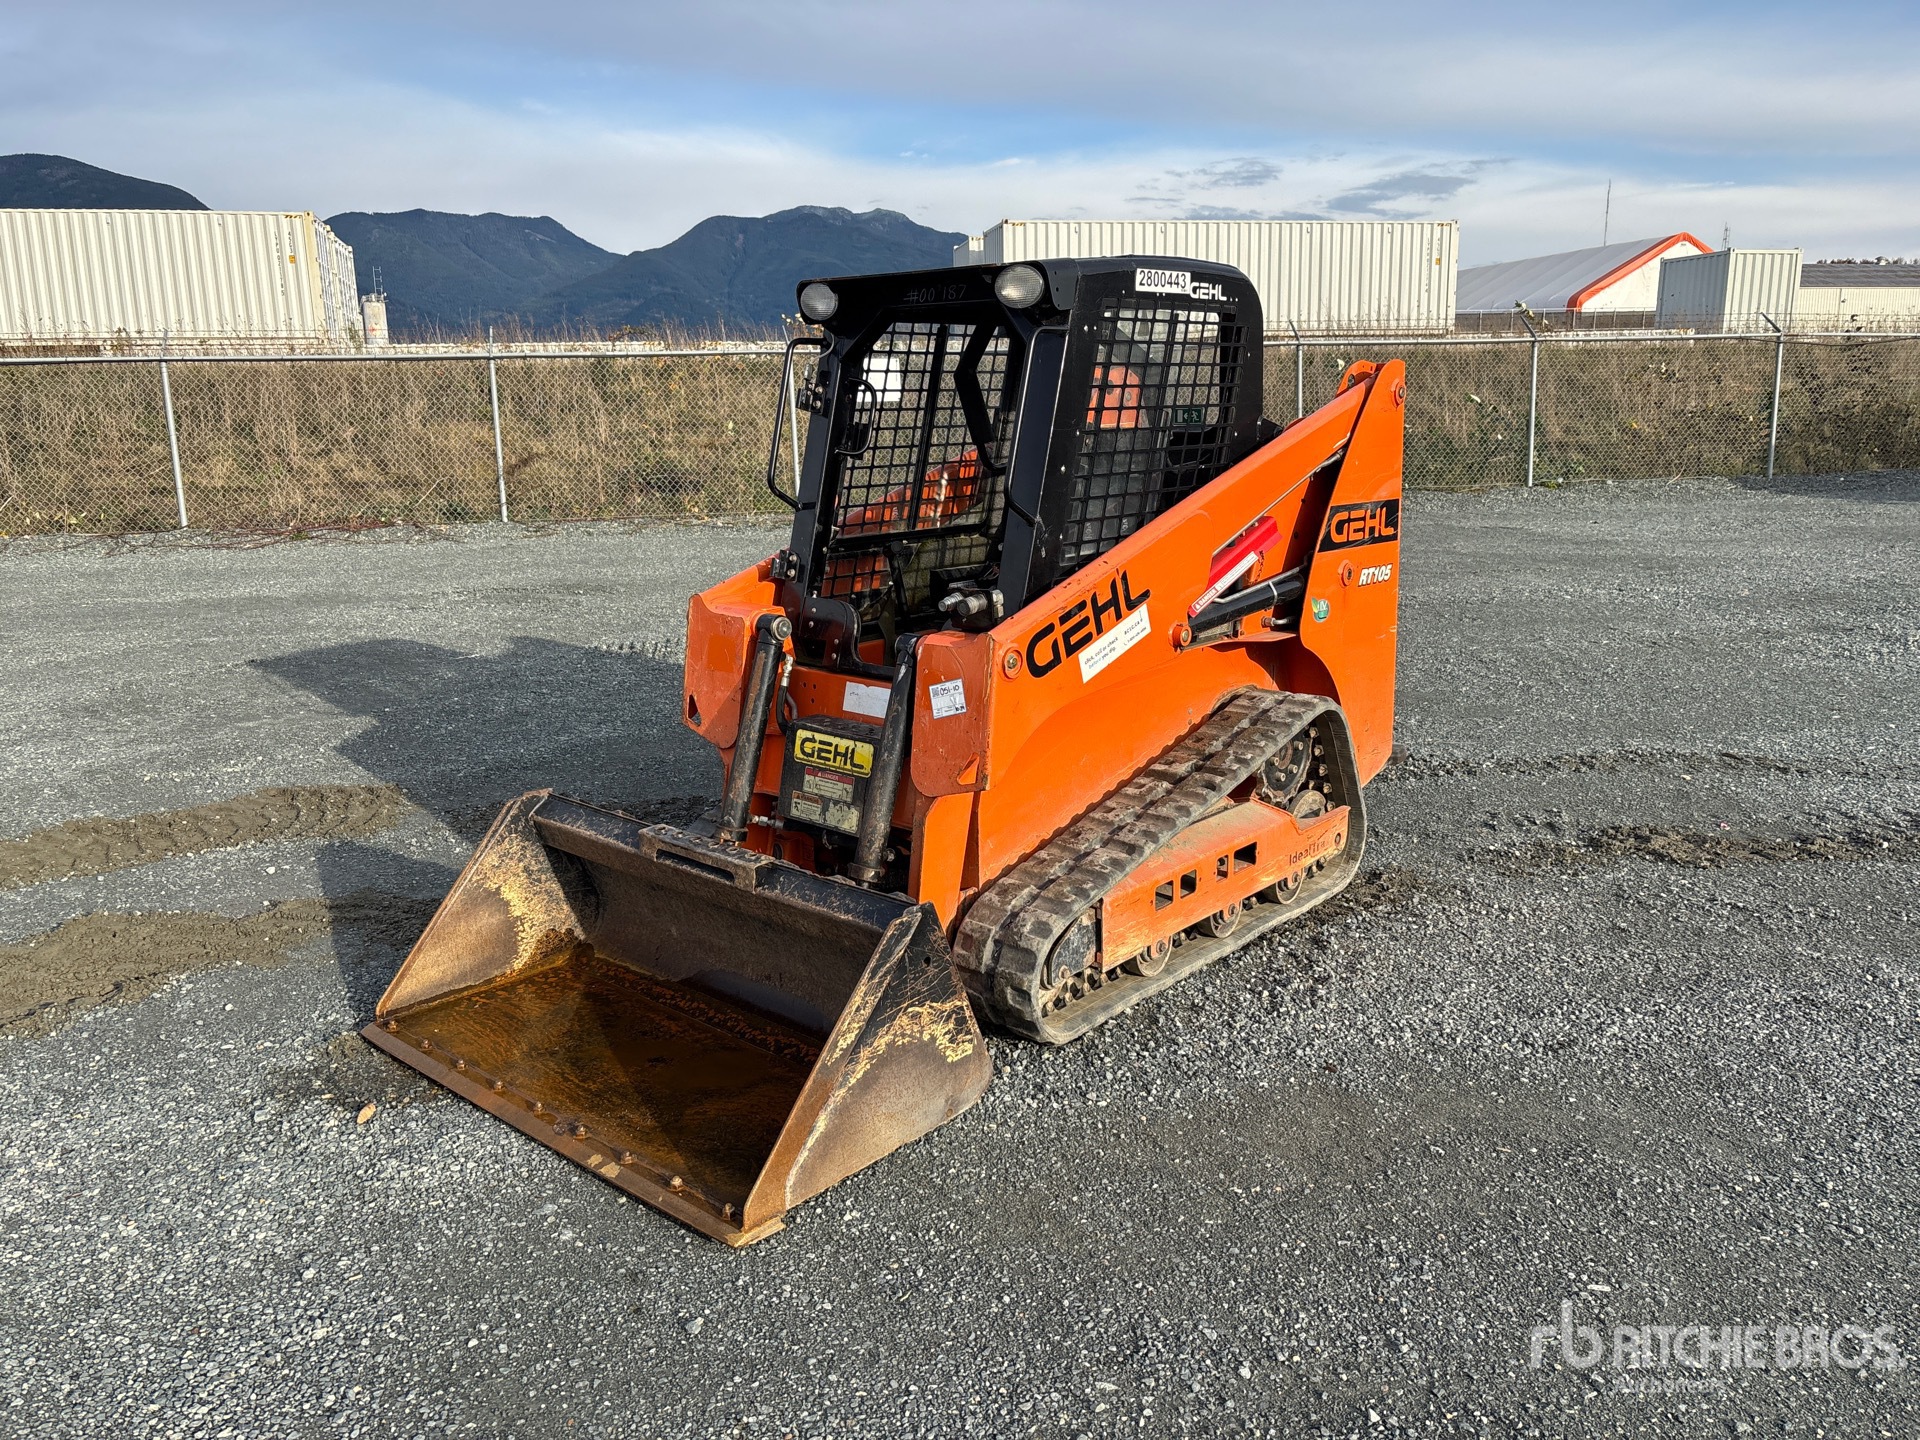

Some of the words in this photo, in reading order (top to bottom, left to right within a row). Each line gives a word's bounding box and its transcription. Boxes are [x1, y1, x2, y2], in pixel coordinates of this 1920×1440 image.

[1139, 270, 1187, 289] 2800443
[1190, 282, 1227, 301] GEHL
[1330, 507, 1395, 543] GEHL
[1358, 563, 1393, 587] RT105
[1026, 570, 1151, 678] GEHL
[800, 735, 864, 770] GEHL
